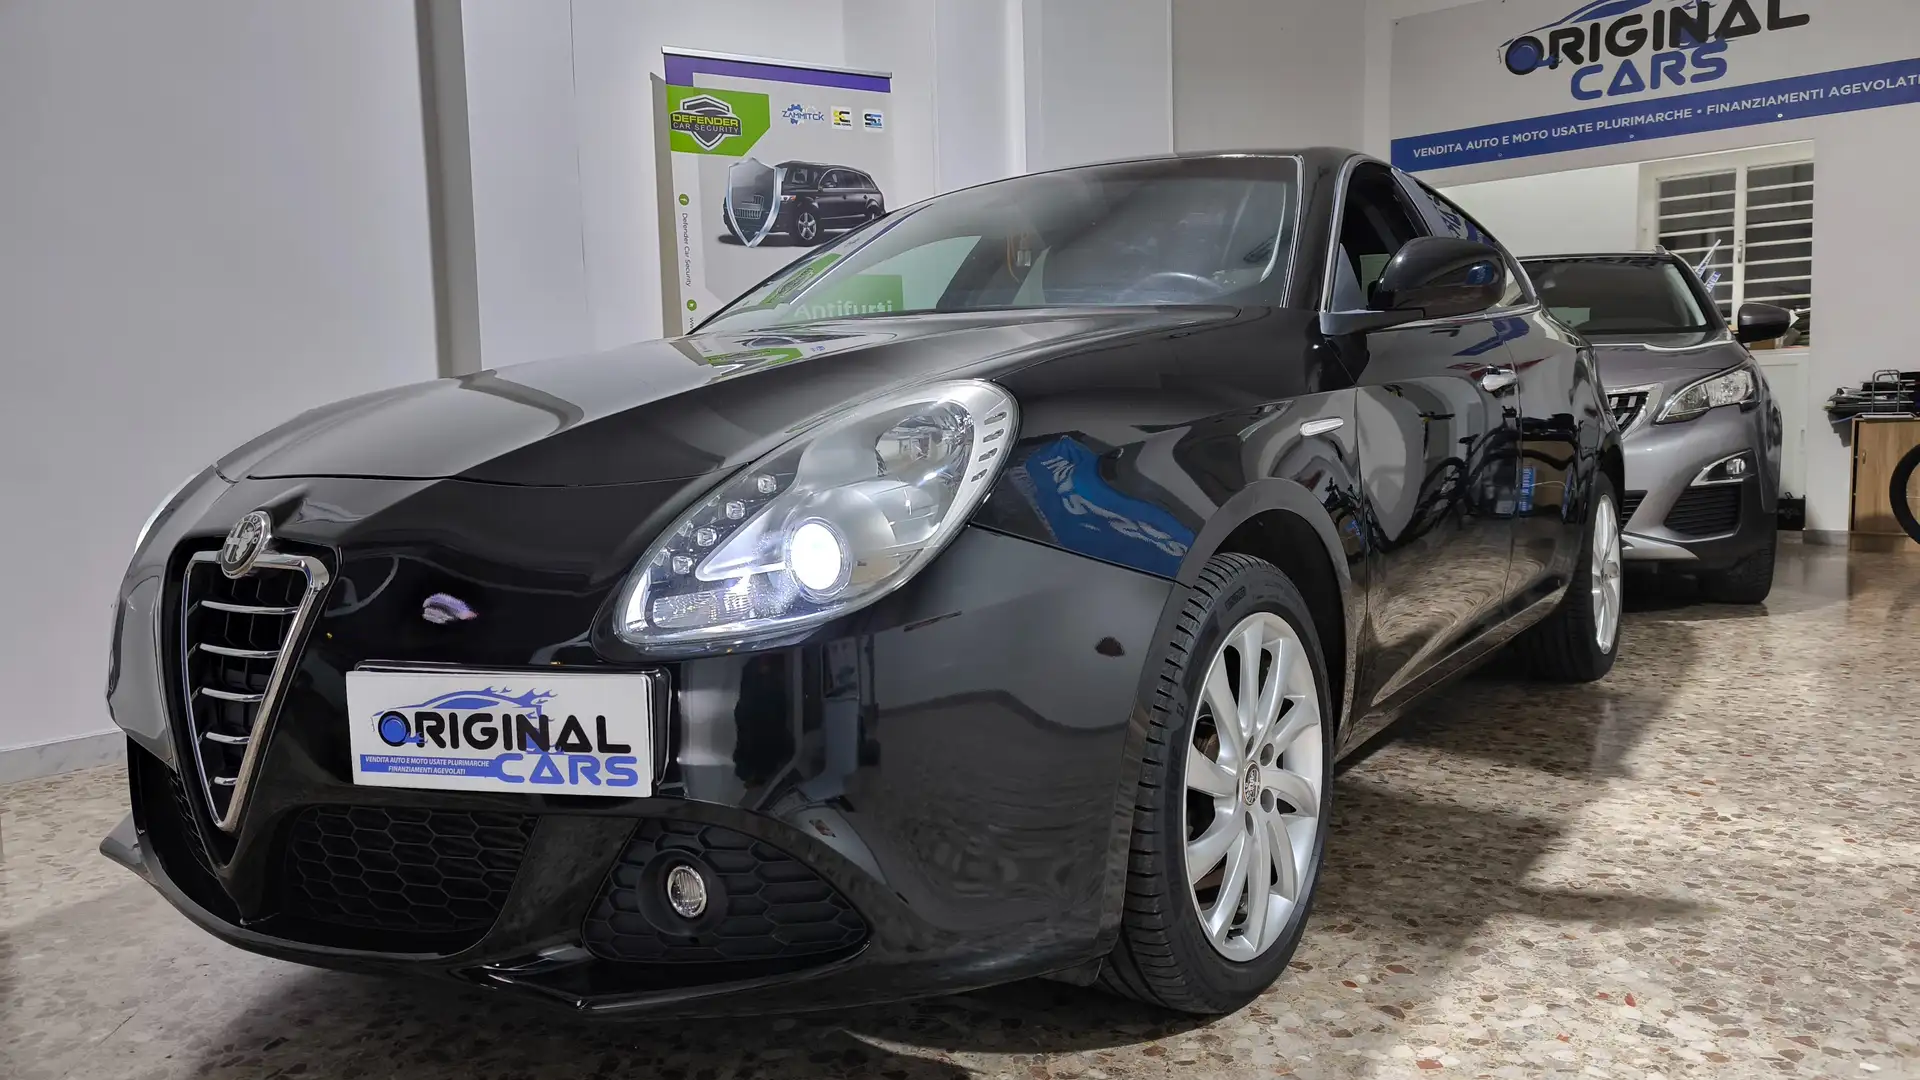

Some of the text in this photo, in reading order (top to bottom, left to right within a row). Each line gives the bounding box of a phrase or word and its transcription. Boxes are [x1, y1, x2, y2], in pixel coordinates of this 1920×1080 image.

[1505, 0, 1810, 75] ORIGINAL
[1571, 39, 1728, 100] CARS
[672, 113, 739, 127] DEFENDER
[673, 122, 739, 134] CAR SECURITY
[1413, 143, 1463, 158] VENDITA
[1465, 138, 1499, 151] AUTO
[1502, 135, 1510, 145] E
[1513, 129, 1548, 144] MOTO
[1552, 123, 1593, 138] USATE
[1597, 108, 1692, 131] PLURIMARCHE
[1706, 89, 1824, 115] FINANZIAMENTI
[682, 213, 690, 245] Defender
[794, 300, 893, 320] Antifurti
[378, 710, 632, 753] ORIGINAL
[365, 755, 389, 763] VENDITA
[389, 756, 405, 764] AUTO
[411, 757, 428, 765] MOTO
[429, 758, 447, 766] USATE
[447, 759, 490, 767] PLURIMARCHE
[388, 765, 466, 775] FINANZIAMENTI AGEVOLATI
[498, 752, 638, 787] CARS
